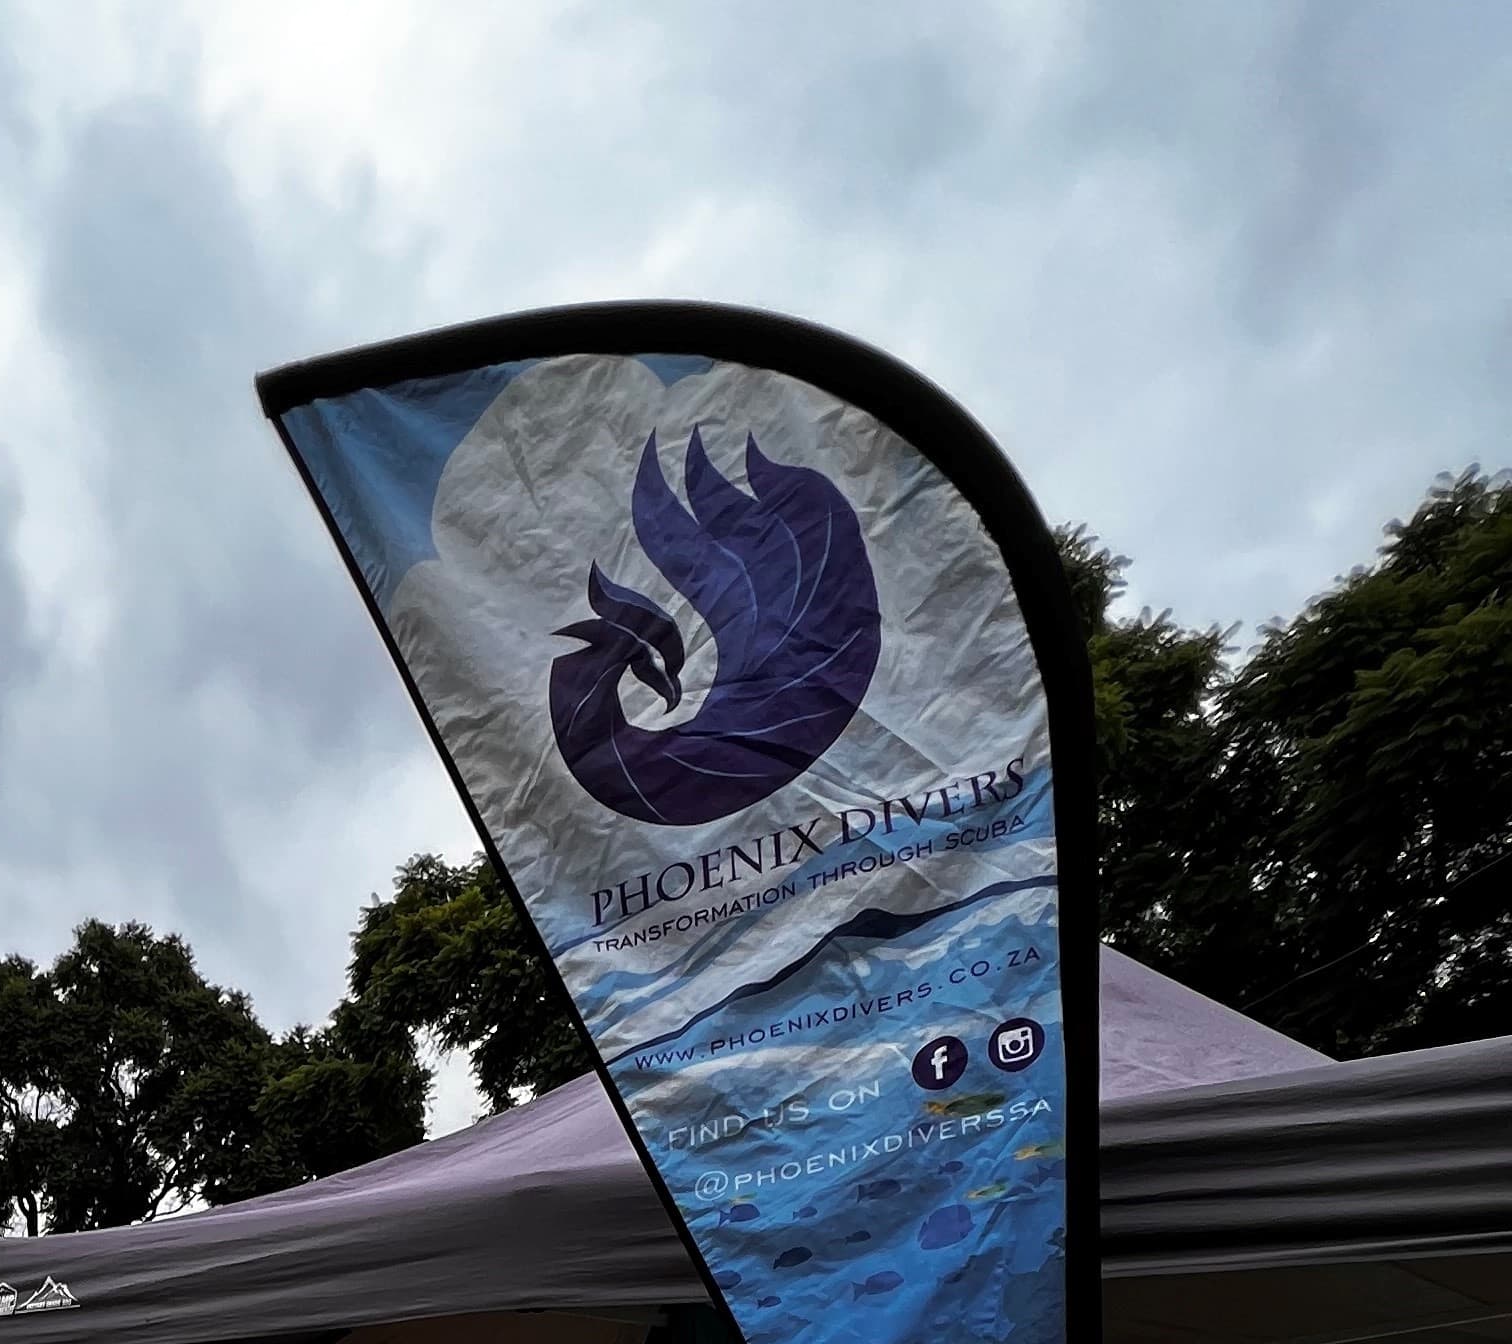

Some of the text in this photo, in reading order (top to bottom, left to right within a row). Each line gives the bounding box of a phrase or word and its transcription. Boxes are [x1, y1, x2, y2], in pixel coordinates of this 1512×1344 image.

[590, 757, 1025, 928] PHOENIX DIVERS
[593, 815, 1025, 952] TRANSFORMATION THROUGH SCUBA
[635, 947, 1040, 1070] WWW.PHOENIXDIVERS.CO.ZA
[669, 1114, 745, 1151] FIND
[764, 1099, 810, 1127] US
[828, 1080, 880, 1112] ON
[695, 1097, 1052, 1201] @PHOENIXDIVERSSA
